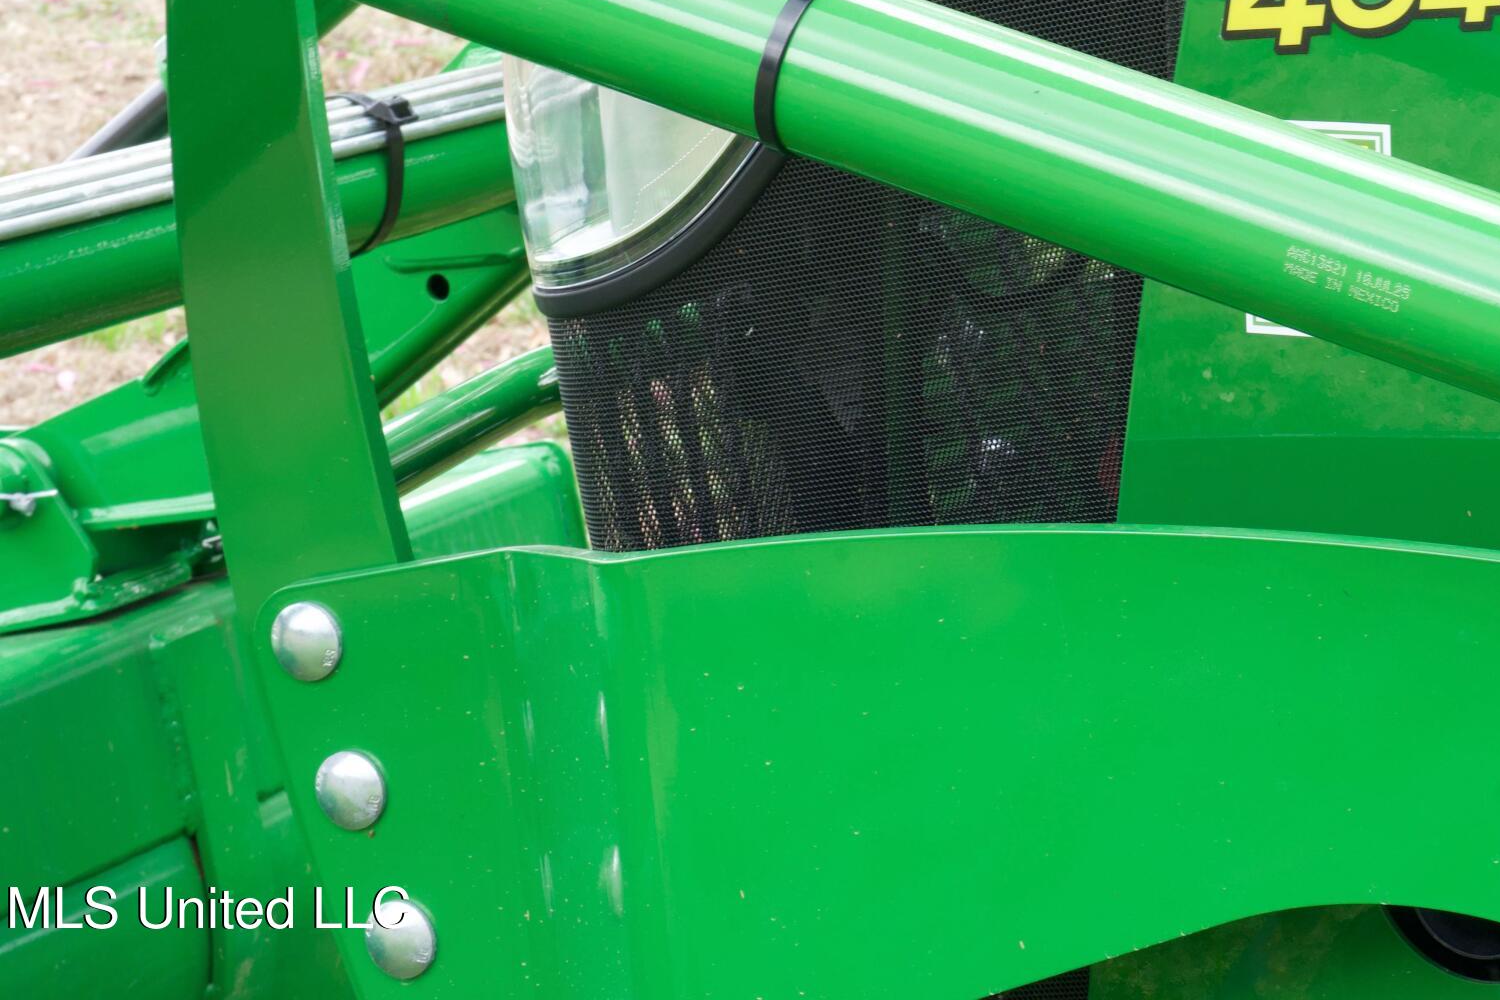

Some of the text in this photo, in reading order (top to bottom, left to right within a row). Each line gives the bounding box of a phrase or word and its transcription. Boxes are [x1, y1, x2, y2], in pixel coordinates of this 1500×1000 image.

[1283, 262, 1400, 313] MADE IN MEXICO
